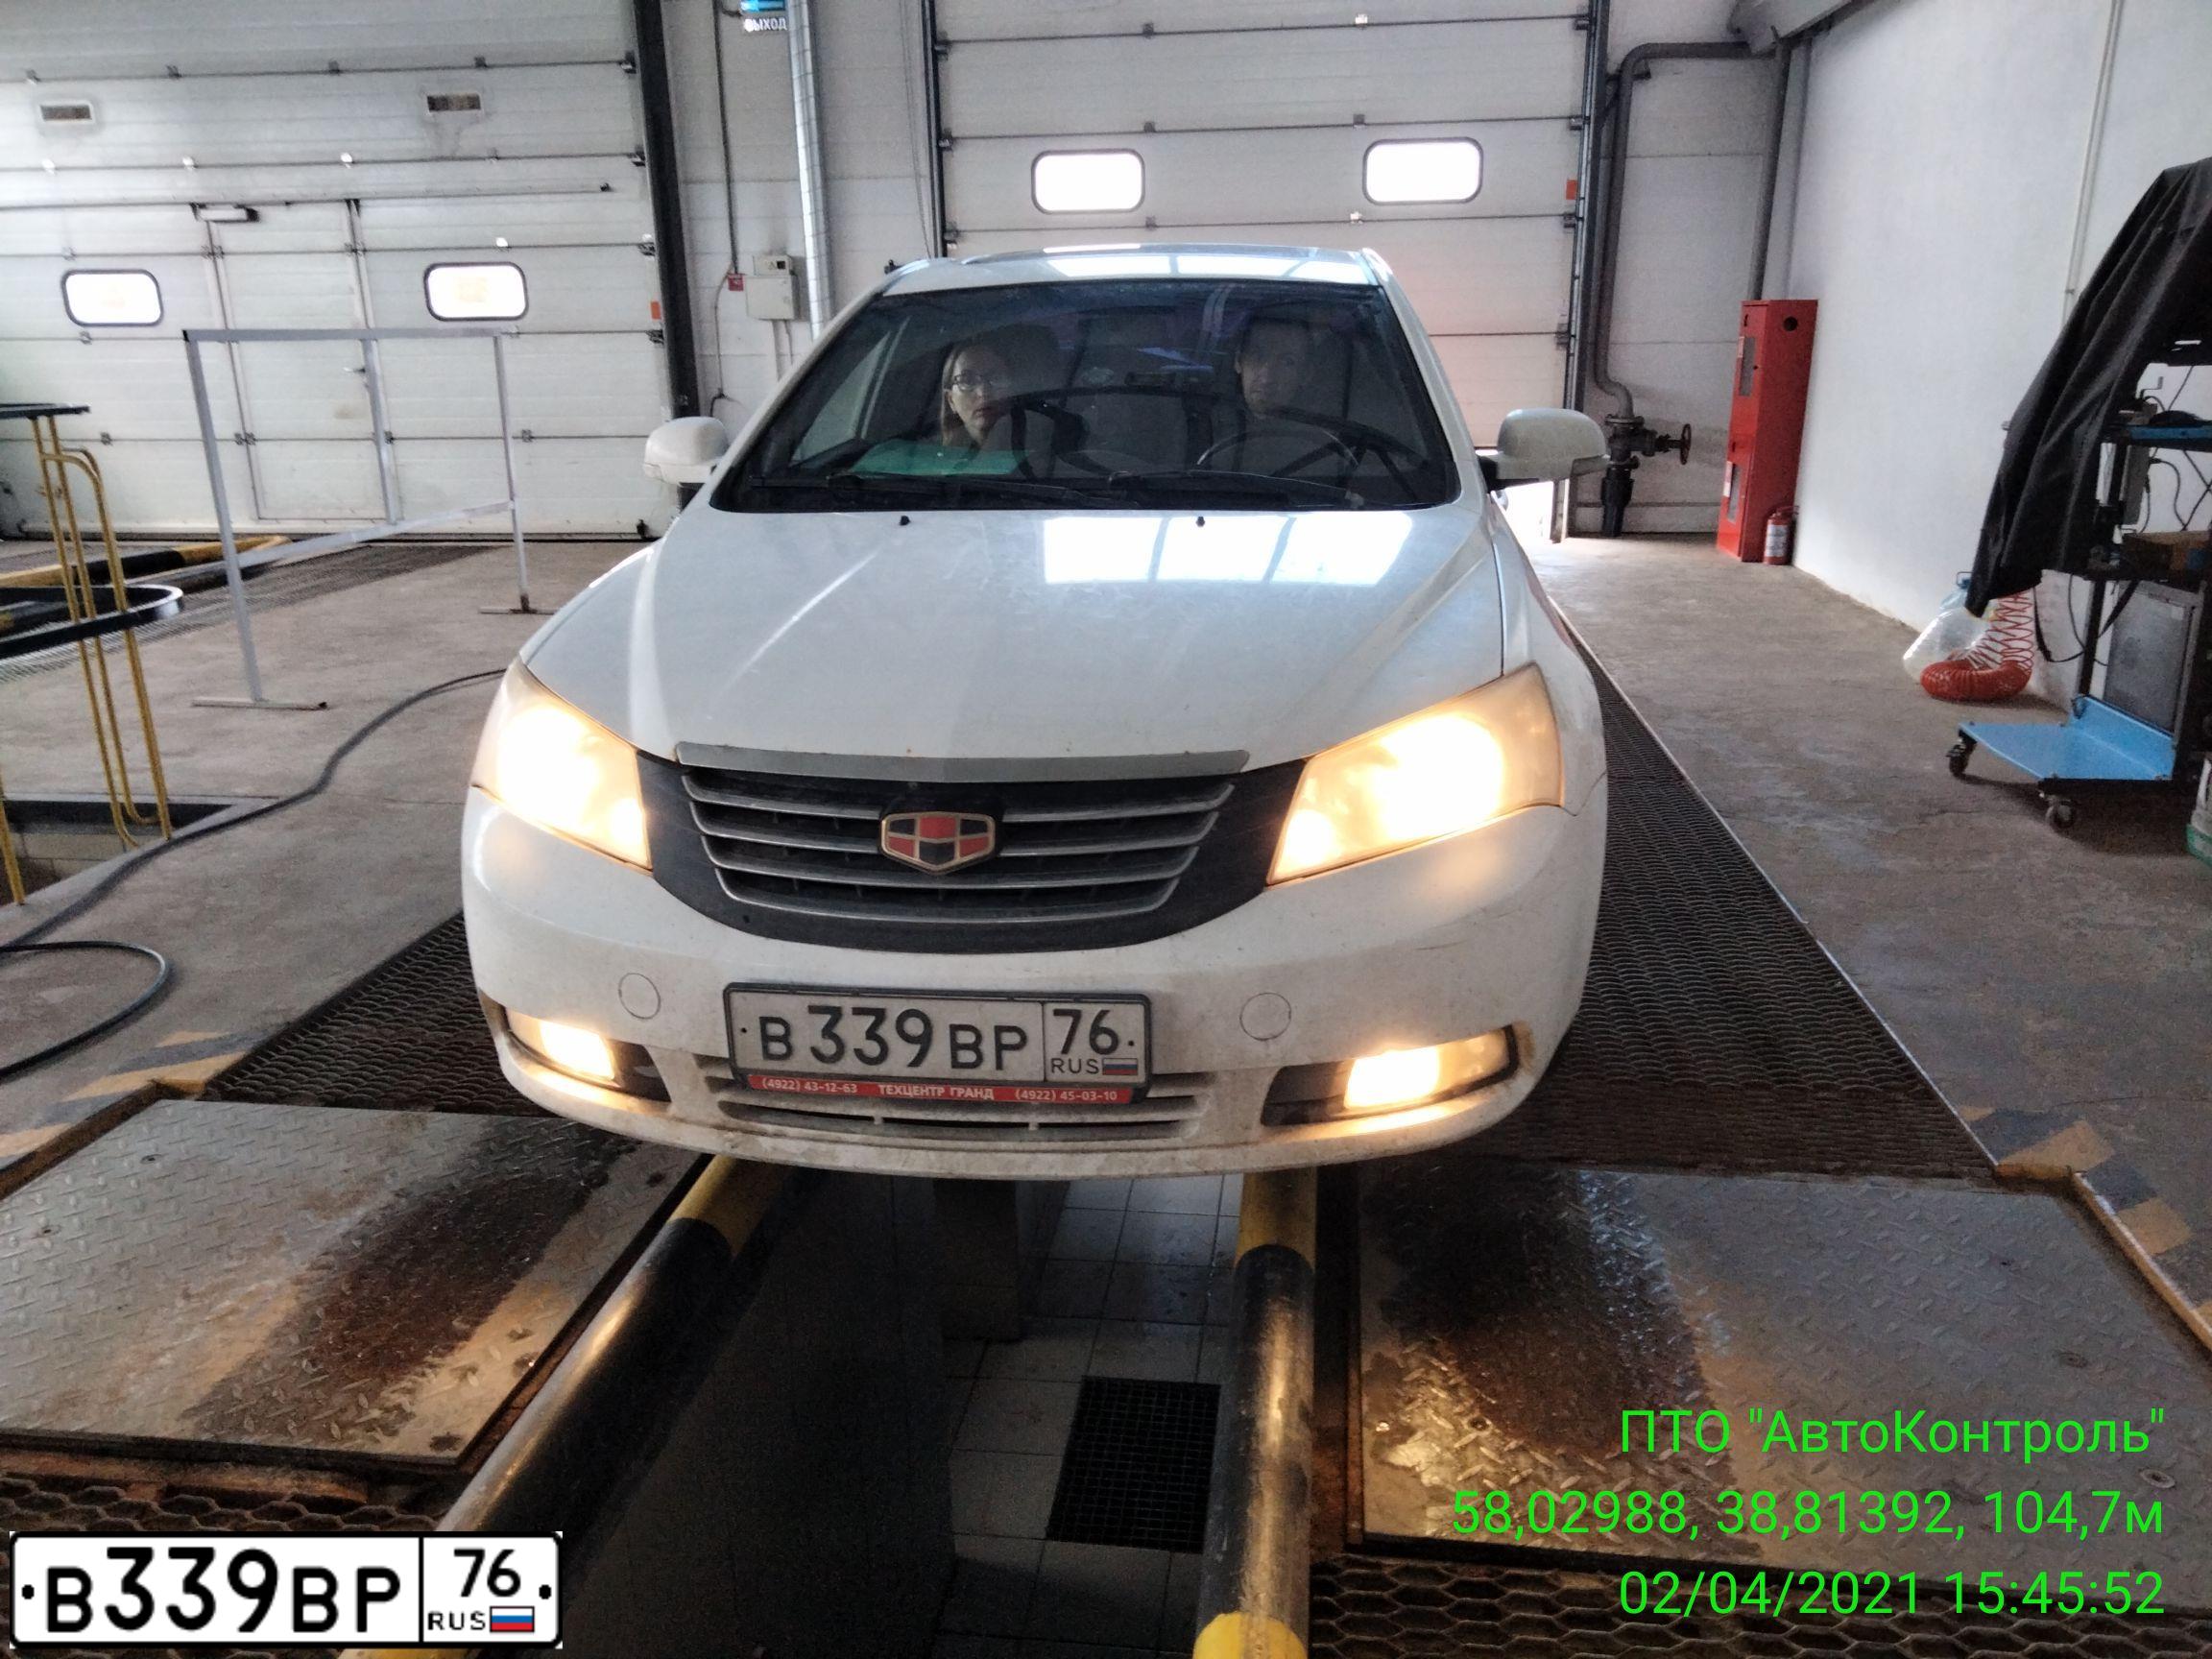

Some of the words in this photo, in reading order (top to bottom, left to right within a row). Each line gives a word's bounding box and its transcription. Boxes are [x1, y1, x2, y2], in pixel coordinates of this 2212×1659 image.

[1052, 1009, 1119, 1056] 76
[1051, 1058, 1100, 1075] RUS
[761, 1078, 801, 1092] (4922)
[804, 1081, 858, 1094] 43-12-63
[878, 1083, 946, 1098] ТЕХЦЕНТР
[949, 1087, 996, 1101] ГРАНД
[1015, 1088, 1057, 1102] (4922)
[1059, 1091, 1118, 1102] 45-03-10
